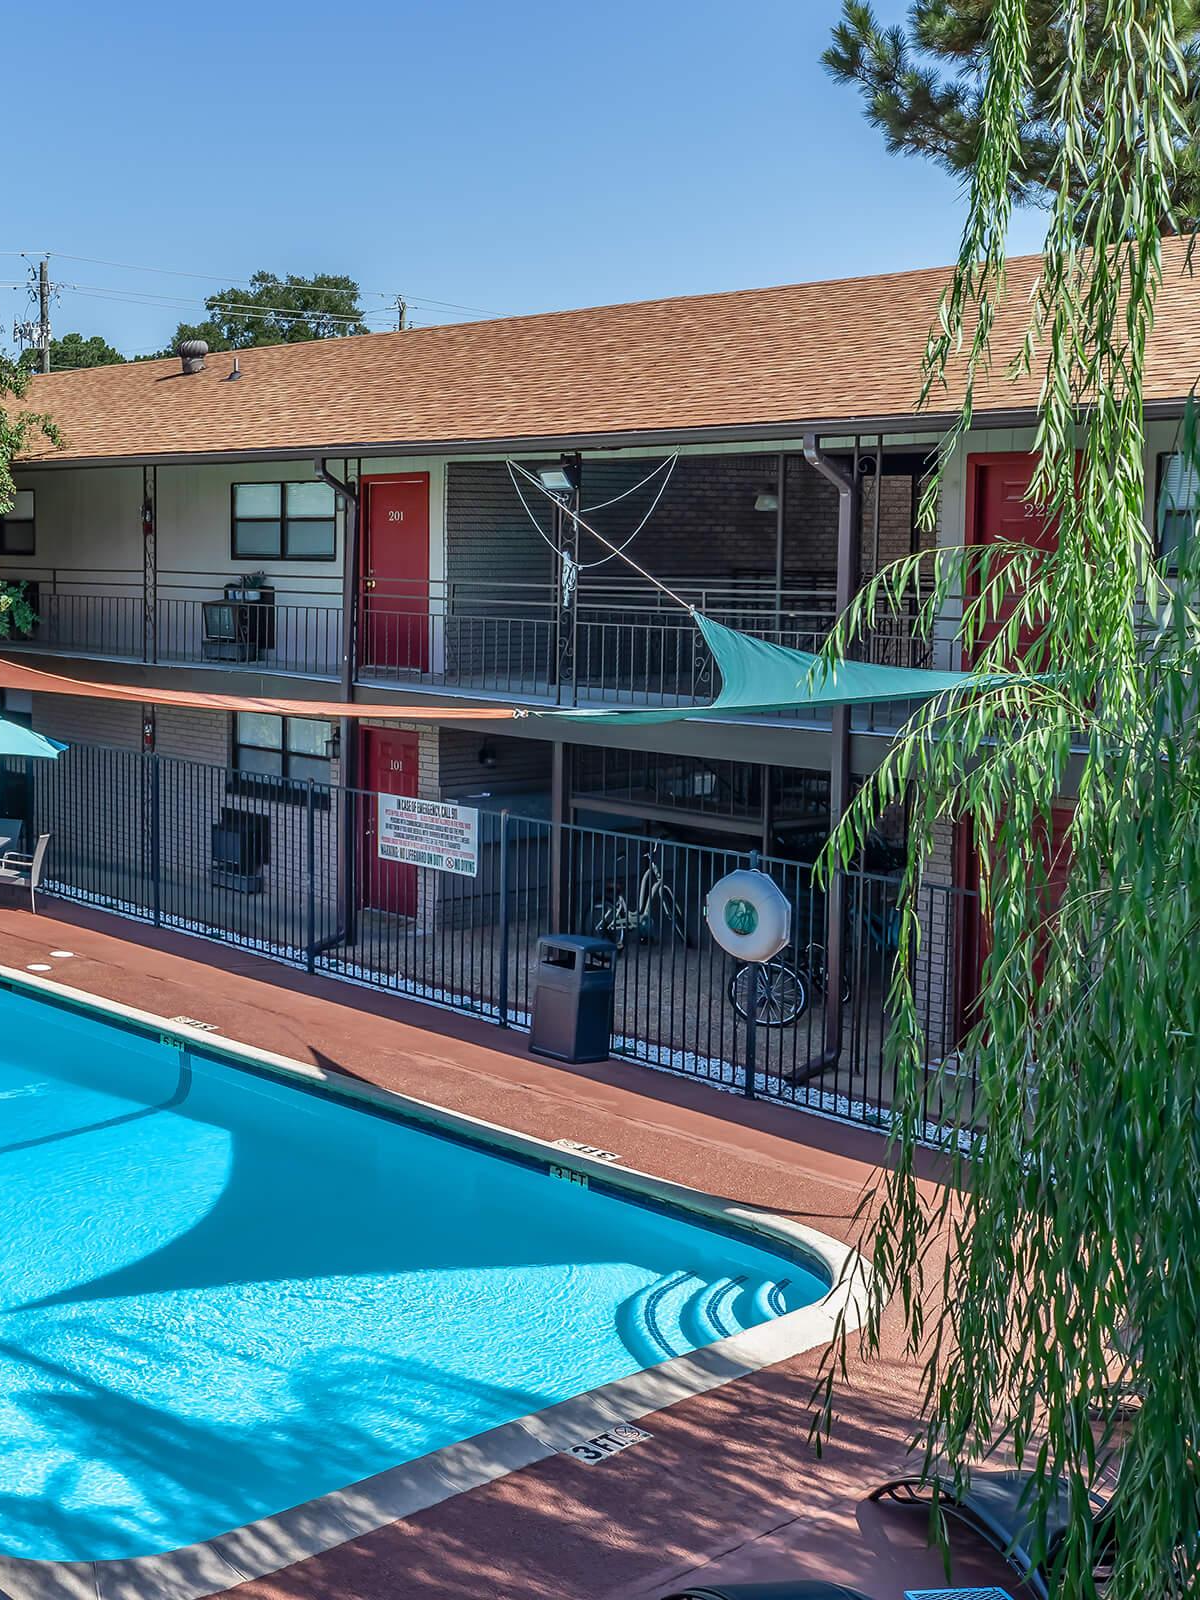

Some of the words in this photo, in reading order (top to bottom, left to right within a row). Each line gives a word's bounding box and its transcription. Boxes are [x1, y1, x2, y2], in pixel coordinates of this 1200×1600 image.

[388, 510, 404, 521] 201
[390, 759, 403, 771] 101
[397, 798, 401, 810] IN
[401, 799, 412, 812] CASE
[411, 800, 417, 813] OF
[441, 805, 451, 819] CALL
[399, 847, 406, 860] NO
[405, 848, 427, 864] LIFEGUARD
[427, 852, 433, 865] ON
[433, 853, 444, 867] DUTY
[454, 858, 461, 871] NO
[460, 859, 476, 874] DIVING
[555, 1166, 564, 1180] 3
[568, 1168, 587, 1187] FT
[571, 1445, 603, 1460] 3
